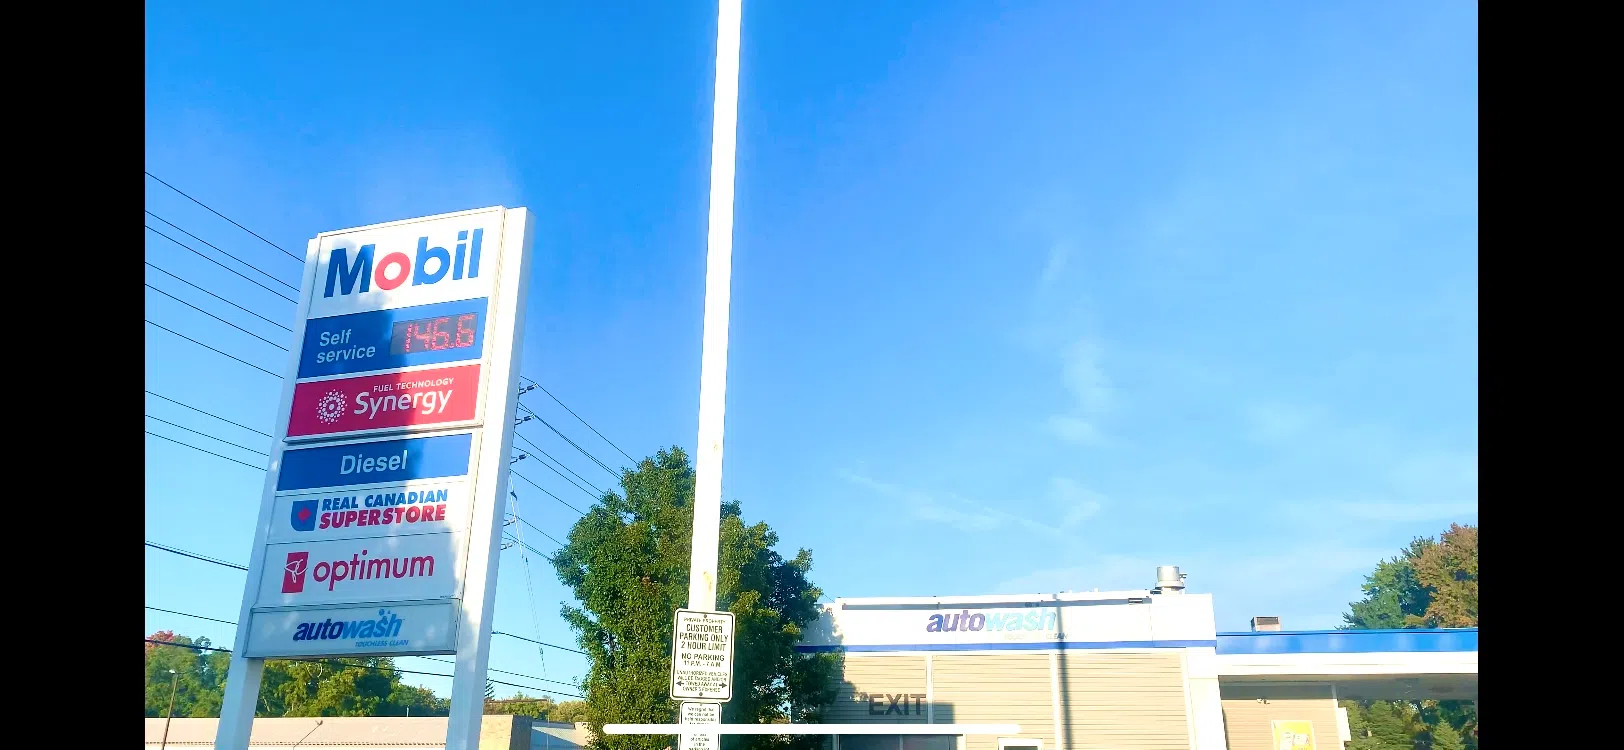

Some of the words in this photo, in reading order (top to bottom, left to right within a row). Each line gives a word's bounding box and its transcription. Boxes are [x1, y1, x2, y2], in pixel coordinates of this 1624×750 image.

[324, 227, 483, 299] Mobil
[319, 329, 352, 347] Self
[404, 315, 475, 352] 146.6
[316, 345, 376, 364] service
[373, 383, 393, 393] FUEL
[395, 377, 454, 390] TECHNOLOGY
[354, 388, 453, 420] Synergy
[340, 450, 408, 475] Diesel
[322, 496, 359, 511] REAL
[364, 489, 448, 508] CANADIAN
[319, 504, 447, 529] SUPERSTORE
[313, 549, 434, 591] optimum
[293, 609, 403, 641] autowash
[687, 624, 722, 633] CUSTOMER
[926, 608, 1056, 634] autowash
[680, 632, 708, 641] PARKING
[711, 634, 728, 642] ONLY
[688, 641, 706, 649] HOUR
[708, 643, 726, 651] LIMIT
[869, 694, 926, 715] EXIT
